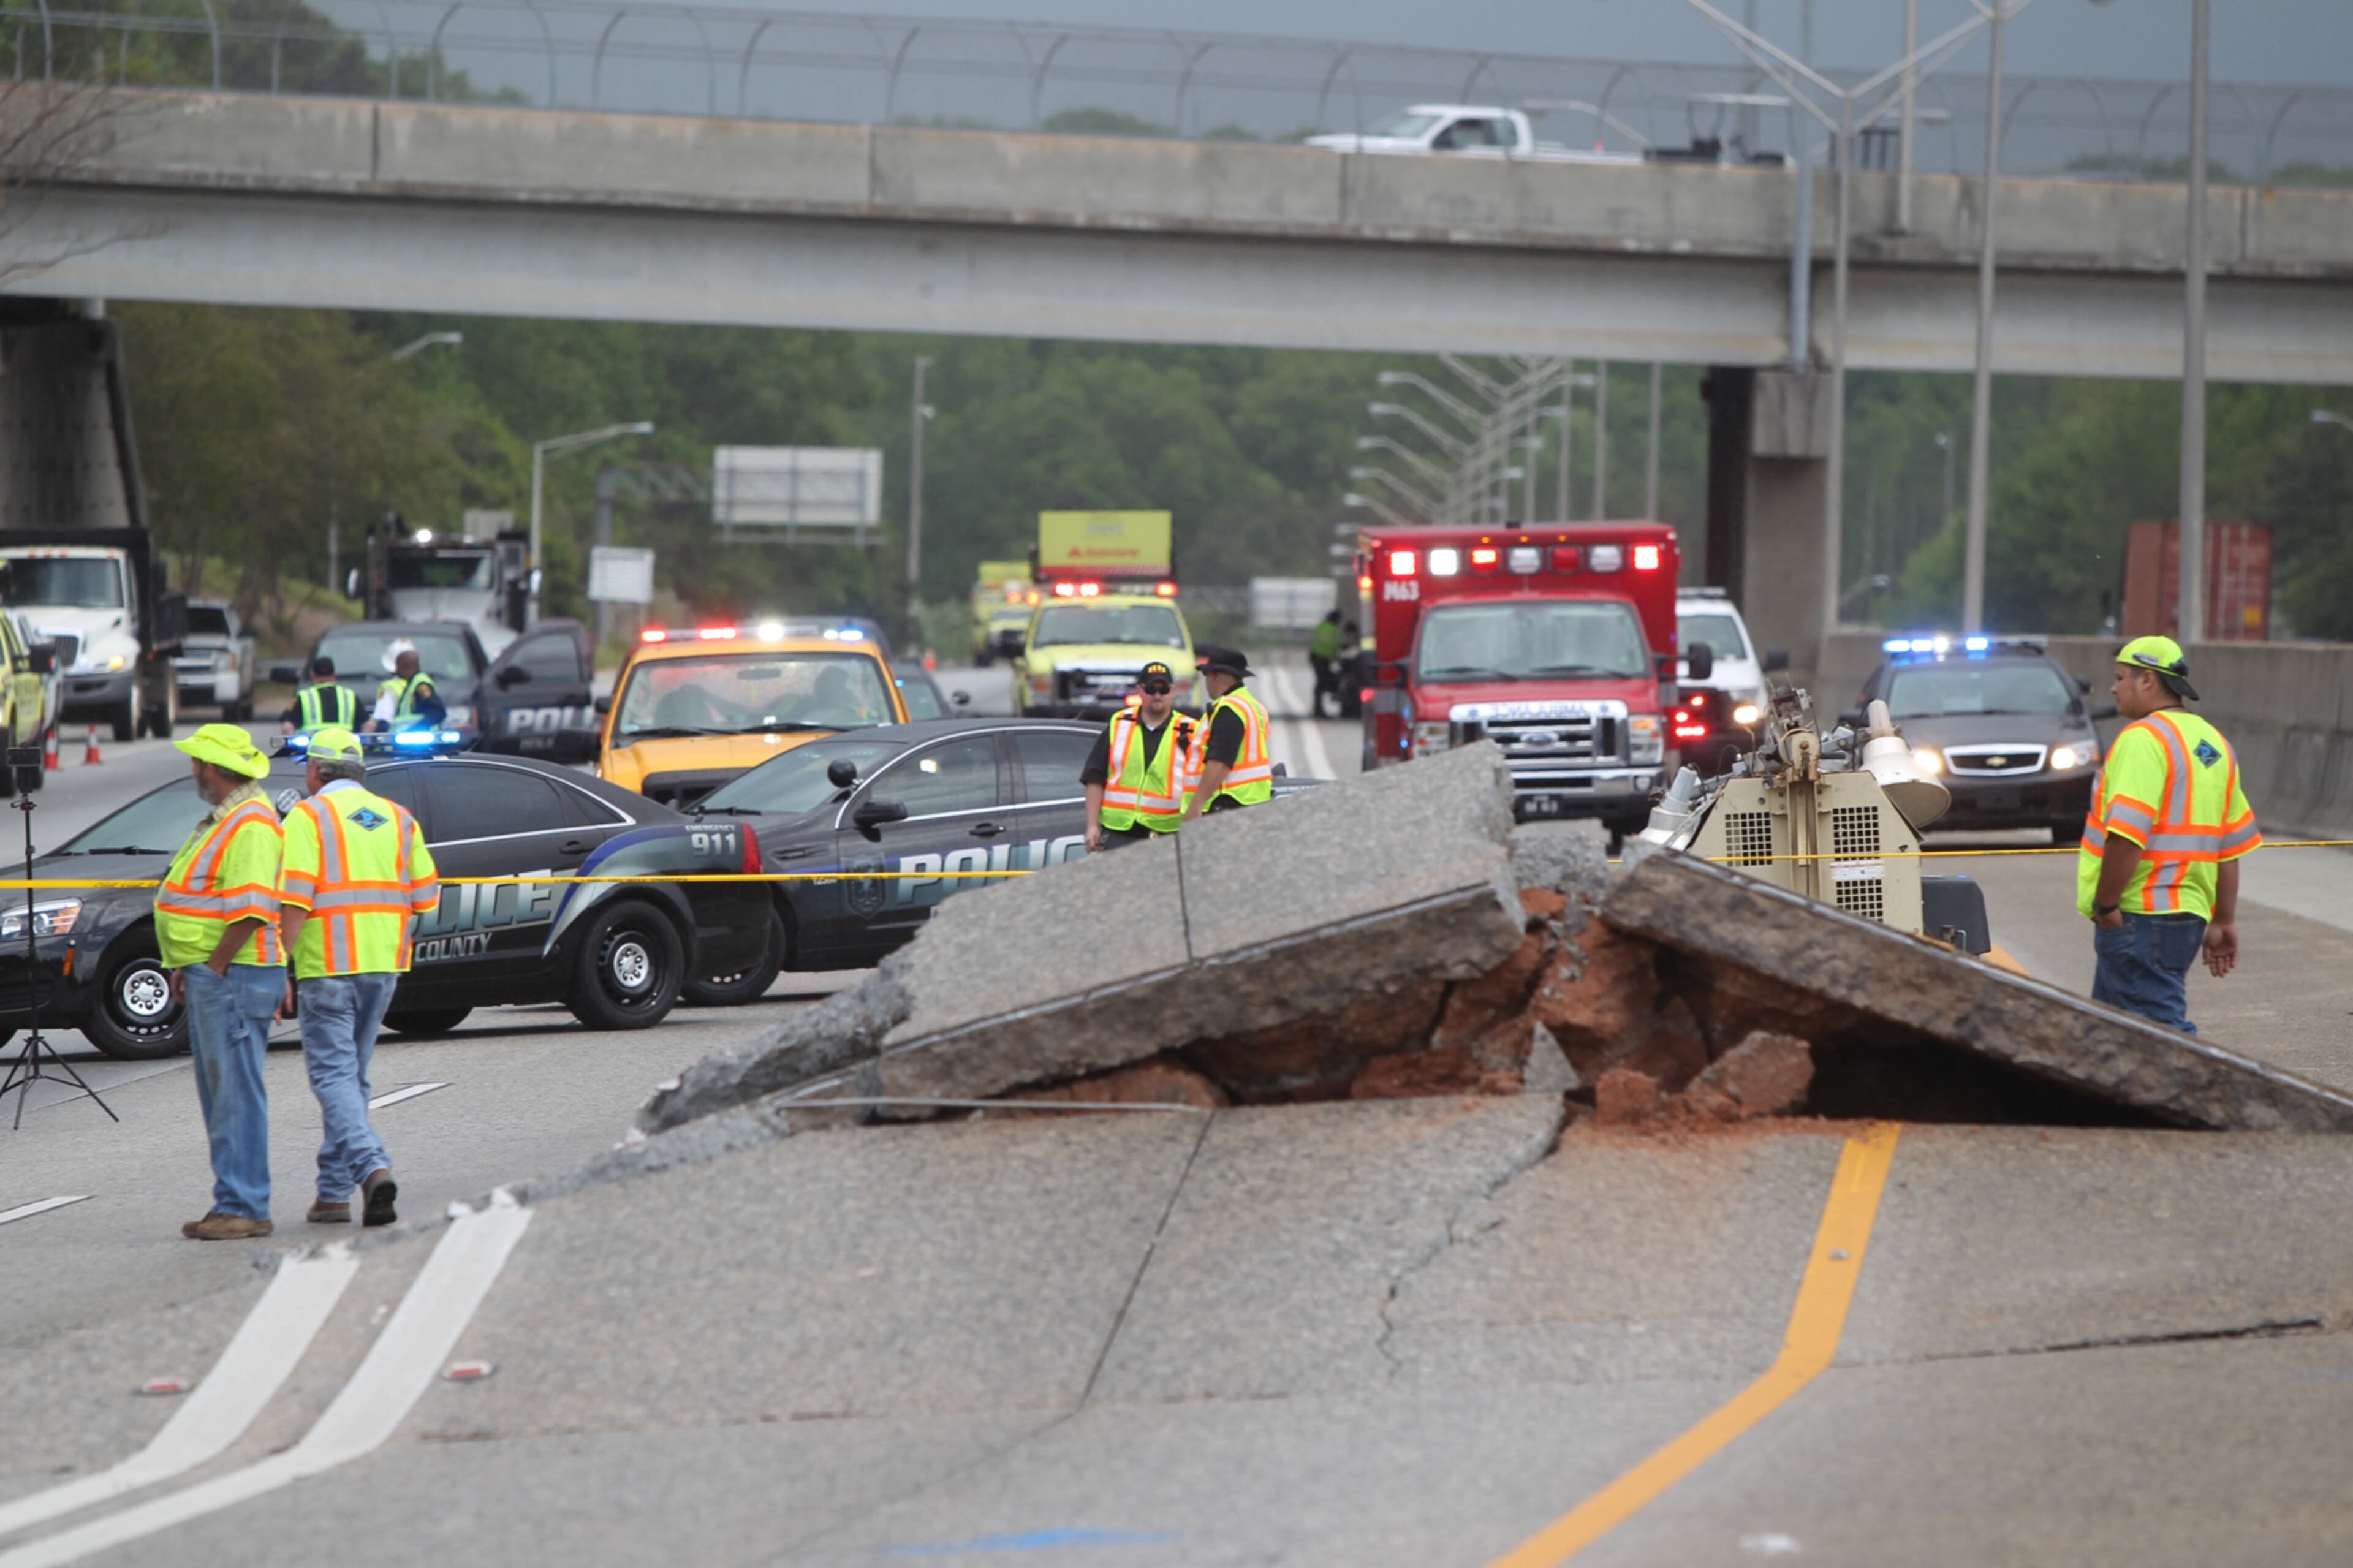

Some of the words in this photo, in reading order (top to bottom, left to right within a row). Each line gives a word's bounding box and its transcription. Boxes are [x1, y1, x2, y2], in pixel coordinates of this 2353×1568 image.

[507, 705, 594, 735] POLI
[692, 833, 735, 855] 911
[896, 834, 1085, 906] POLI
[409, 869, 551, 937] LICE
[414, 933, 492, 962] COUNTY
